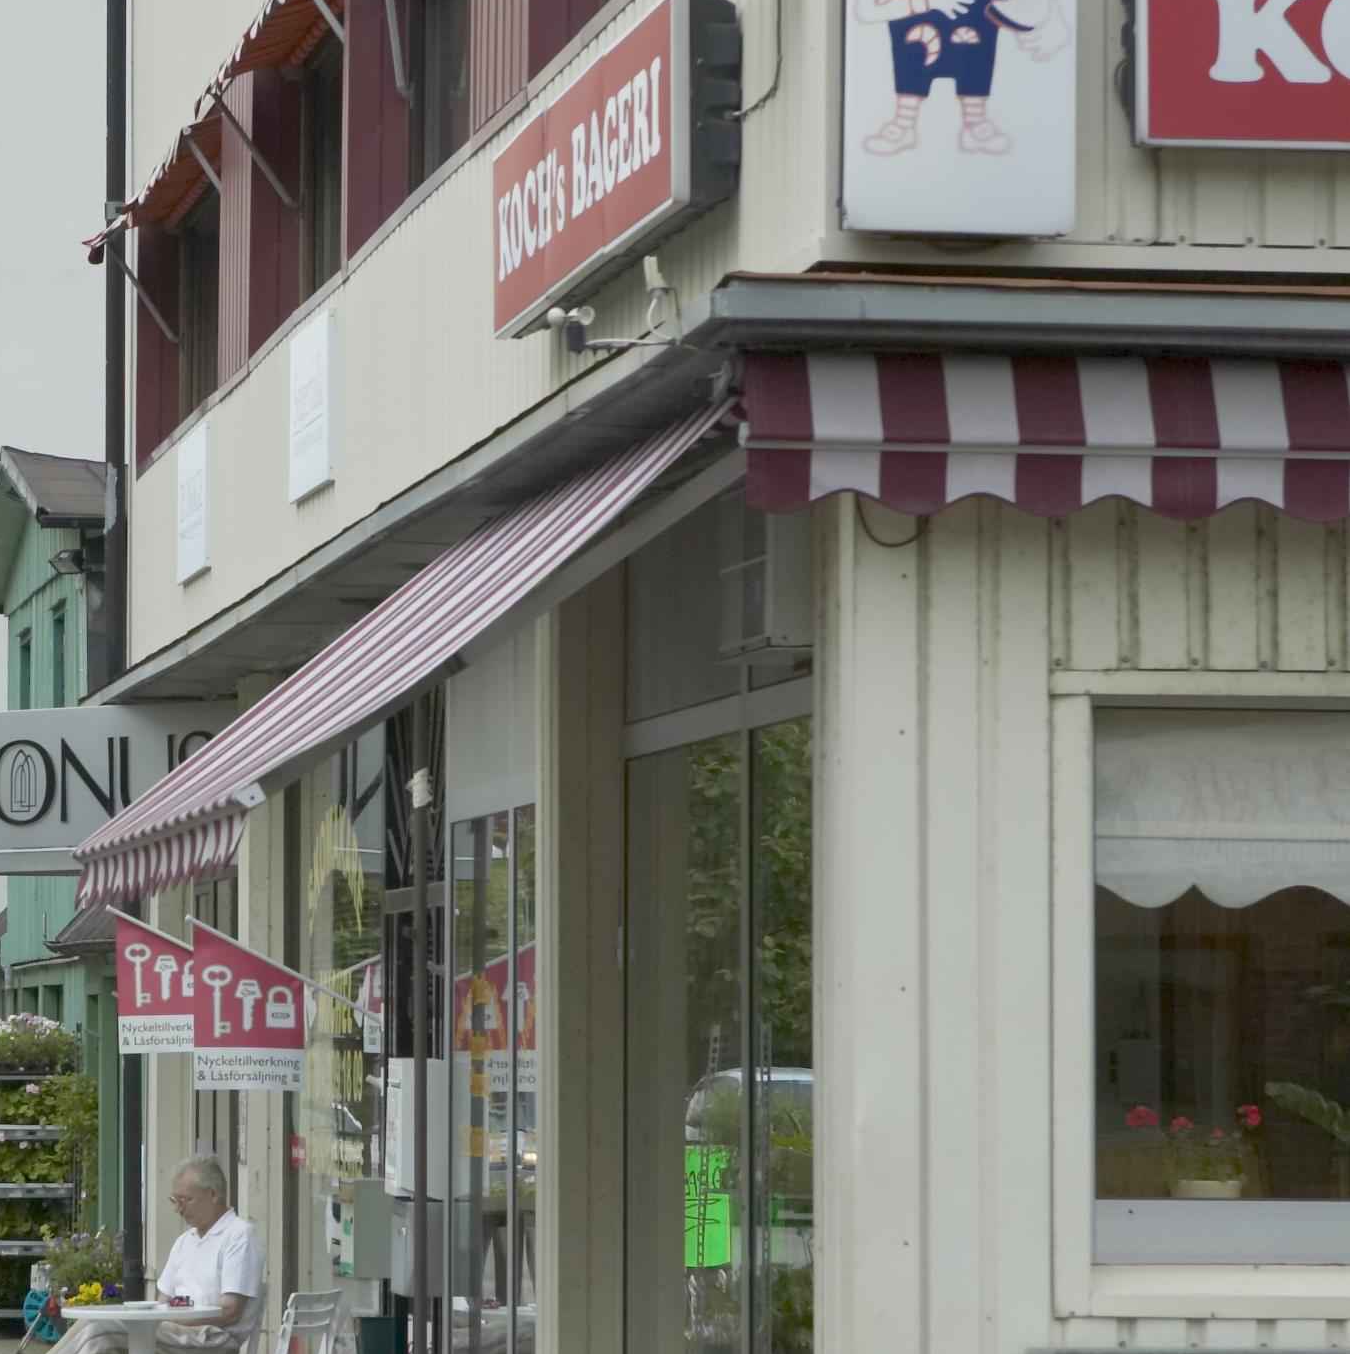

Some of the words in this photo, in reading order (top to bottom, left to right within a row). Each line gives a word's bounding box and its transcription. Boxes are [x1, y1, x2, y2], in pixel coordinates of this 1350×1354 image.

[498, 148, 566, 282] KOCH's
[571, 56, 661, 219] BAGERI
[122, 1037, 130, 1045] &
[197, 1055, 300, 1070] Nyckeltillverkning
[197, 1071, 206, 1081] &
[210, 1070, 288, 1085] Låsförsäljning
